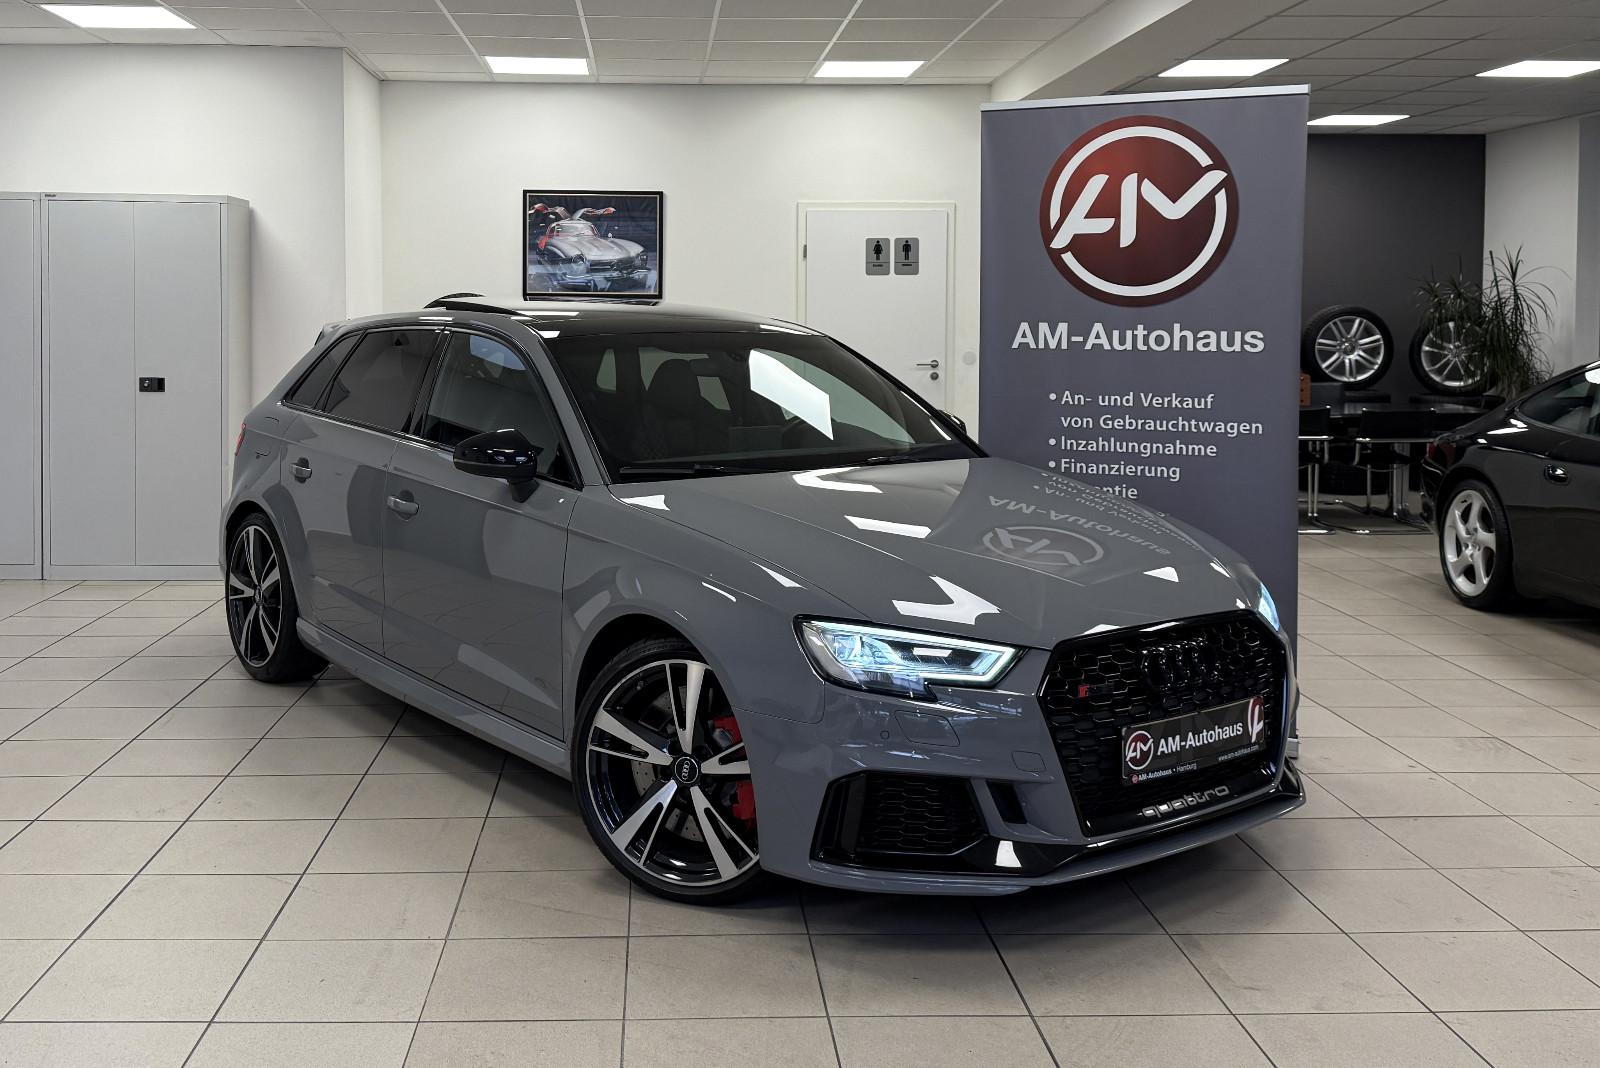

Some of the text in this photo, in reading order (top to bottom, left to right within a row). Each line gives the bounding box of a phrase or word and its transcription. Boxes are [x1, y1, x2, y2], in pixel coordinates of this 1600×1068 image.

[1049, 169, 1229, 249] AM
[1012, 322, 1265, 353] AM-Autohaus
[1060, 390, 1215, 409] An- und Verkauf
[1060, 414, 1263, 437] von Gebrauchtwagen
[1060, 435, 1217, 457] Inzahlungnahme
[1060, 458, 1181, 482] Finanzierung
[1157, 721, 1244, 756] AM-Autohaus
[1176, 762, 1197, 773] Hamburg
[1141, 785, 1231, 818] quattro
